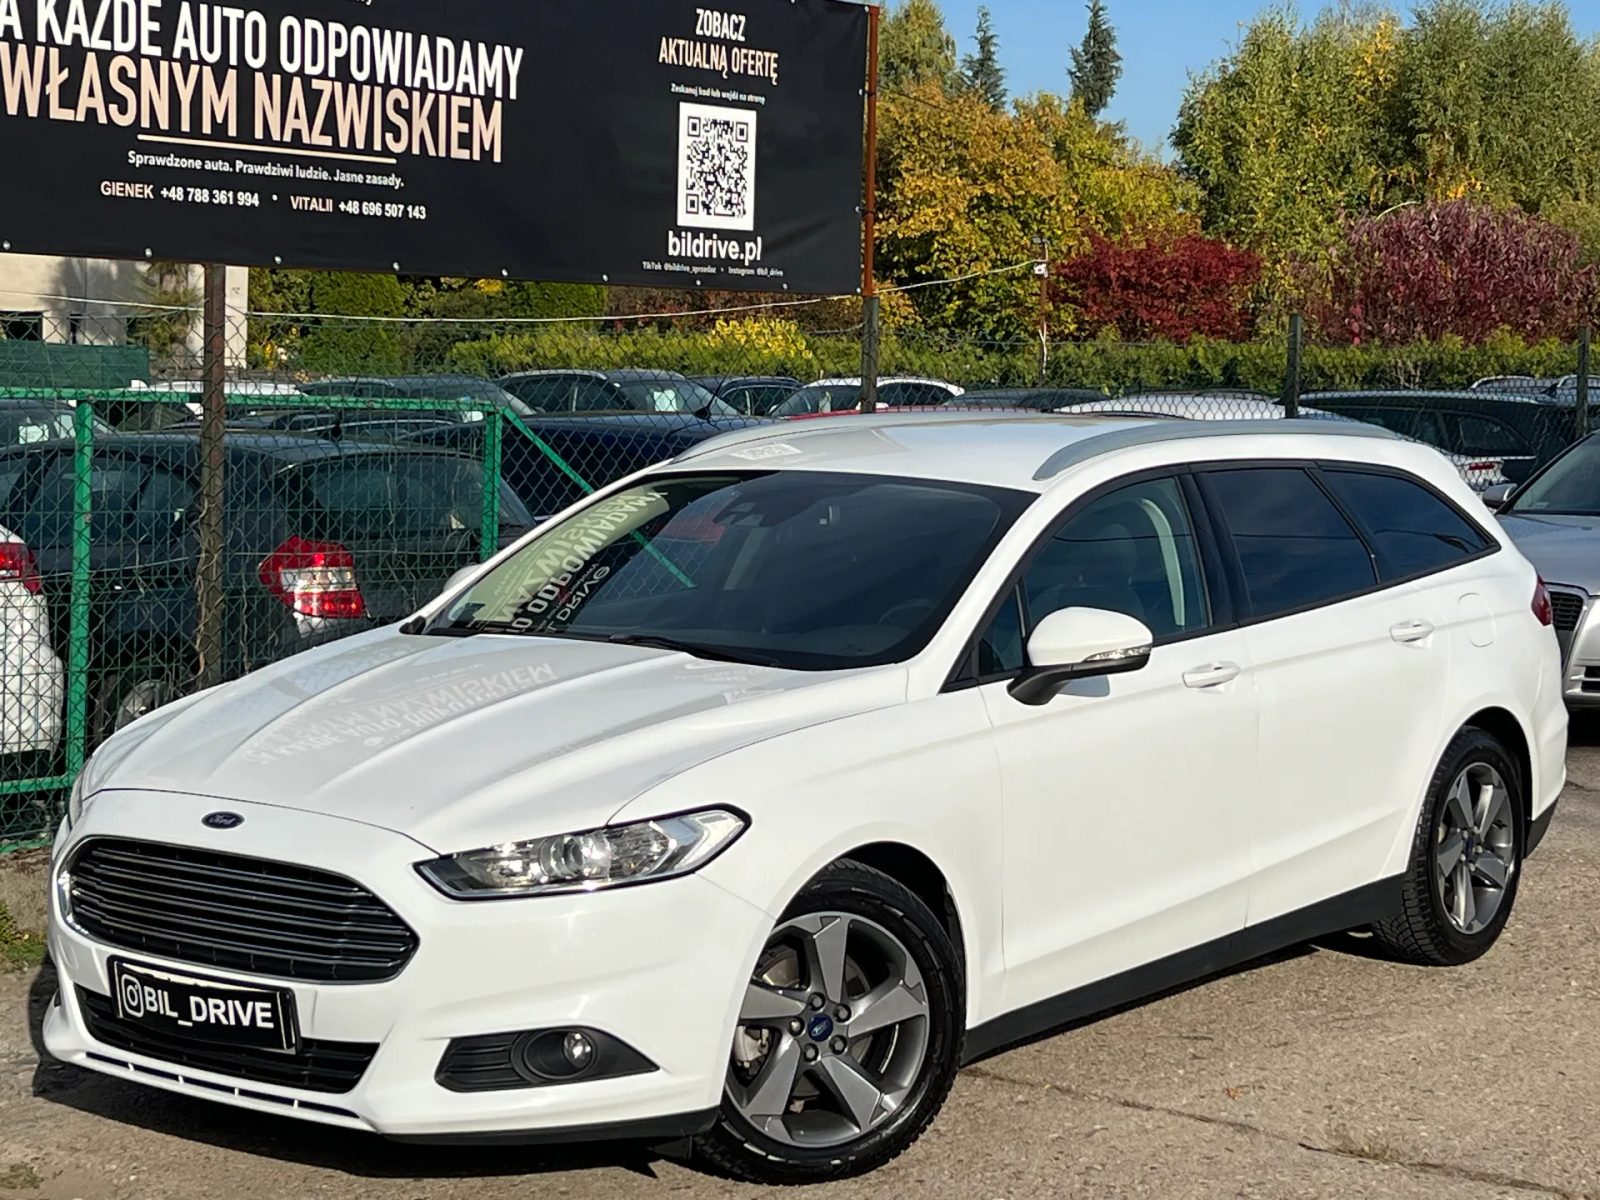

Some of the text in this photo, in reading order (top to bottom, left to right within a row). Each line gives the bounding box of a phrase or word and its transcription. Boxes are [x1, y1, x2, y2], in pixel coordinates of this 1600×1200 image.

[695, 8, 746, 42] ZOBACZ
[172, 1, 266, 69] AUTO
[280, 15, 524, 100] ODPOWIADAMY
[658, 37, 779, 86] AKTUALNĄ OFERTĘ
[0, 41, 503, 163] WŁASNYM NAZWISKIEM
[127, 150, 405, 189] Sprawdzone auta. Prawdziwi ludzie. Jasne zasady.
[100, 181, 259, 207] GIENEK +48 788 361 994
[290, 195, 427, 220] VITALII +48 696 507 143
[668, 230, 762, 266] bildrive.pl
[143, 985, 275, 1029] BIL_DRIVE
